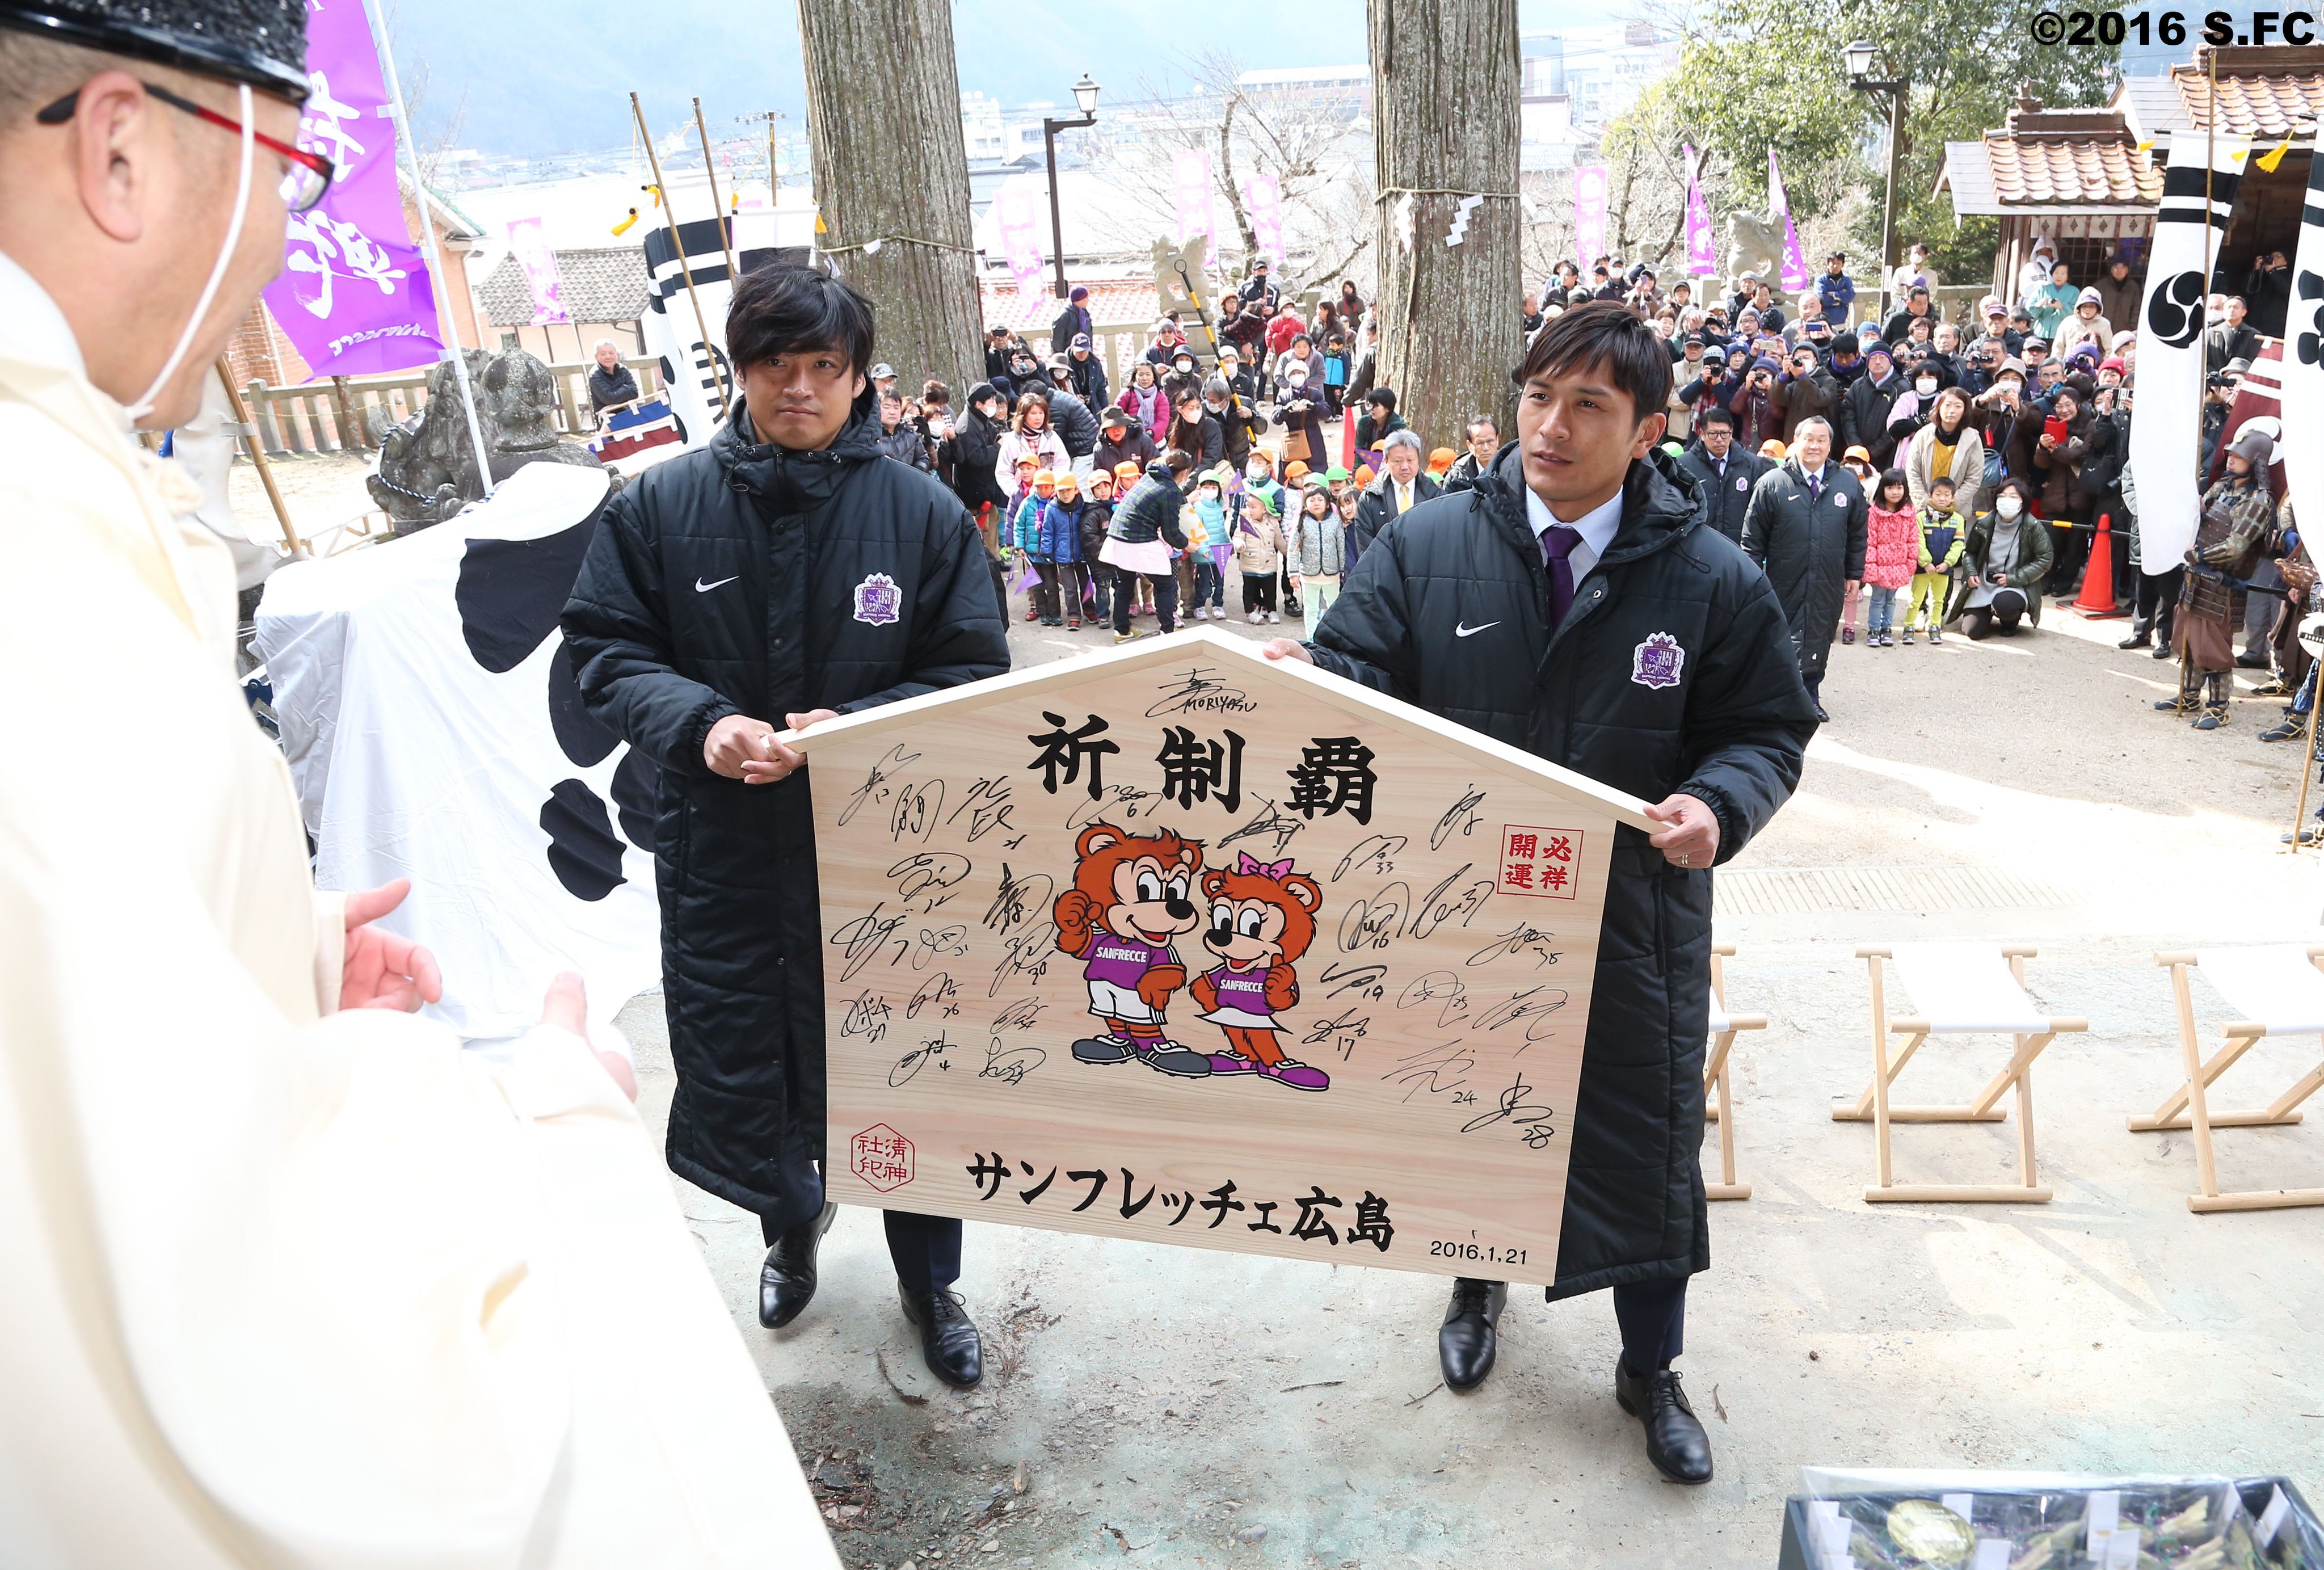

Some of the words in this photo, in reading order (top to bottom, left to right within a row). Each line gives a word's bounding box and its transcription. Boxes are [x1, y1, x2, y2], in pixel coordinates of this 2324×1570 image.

[1182, 696, 1257, 714] MORIYASU
[1027, 710, 1378, 826] 祈制覇
[1506, 834, 1538, 889] 開運
[1372, 931, 1389, 949] 16
[1096, 947, 1147, 962] SANFRECCE
[1220, 979, 1262, 992] SANFRECCE
[1363, 985, 1383, 1001] 19
[1337, 1037, 1355, 1061] 17
[1452, 1092, 1477, 1106] 24
[1521, 1125, 1555, 1150] 28
[966, 1151, 1395, 1252] サンフレッチェ広島
